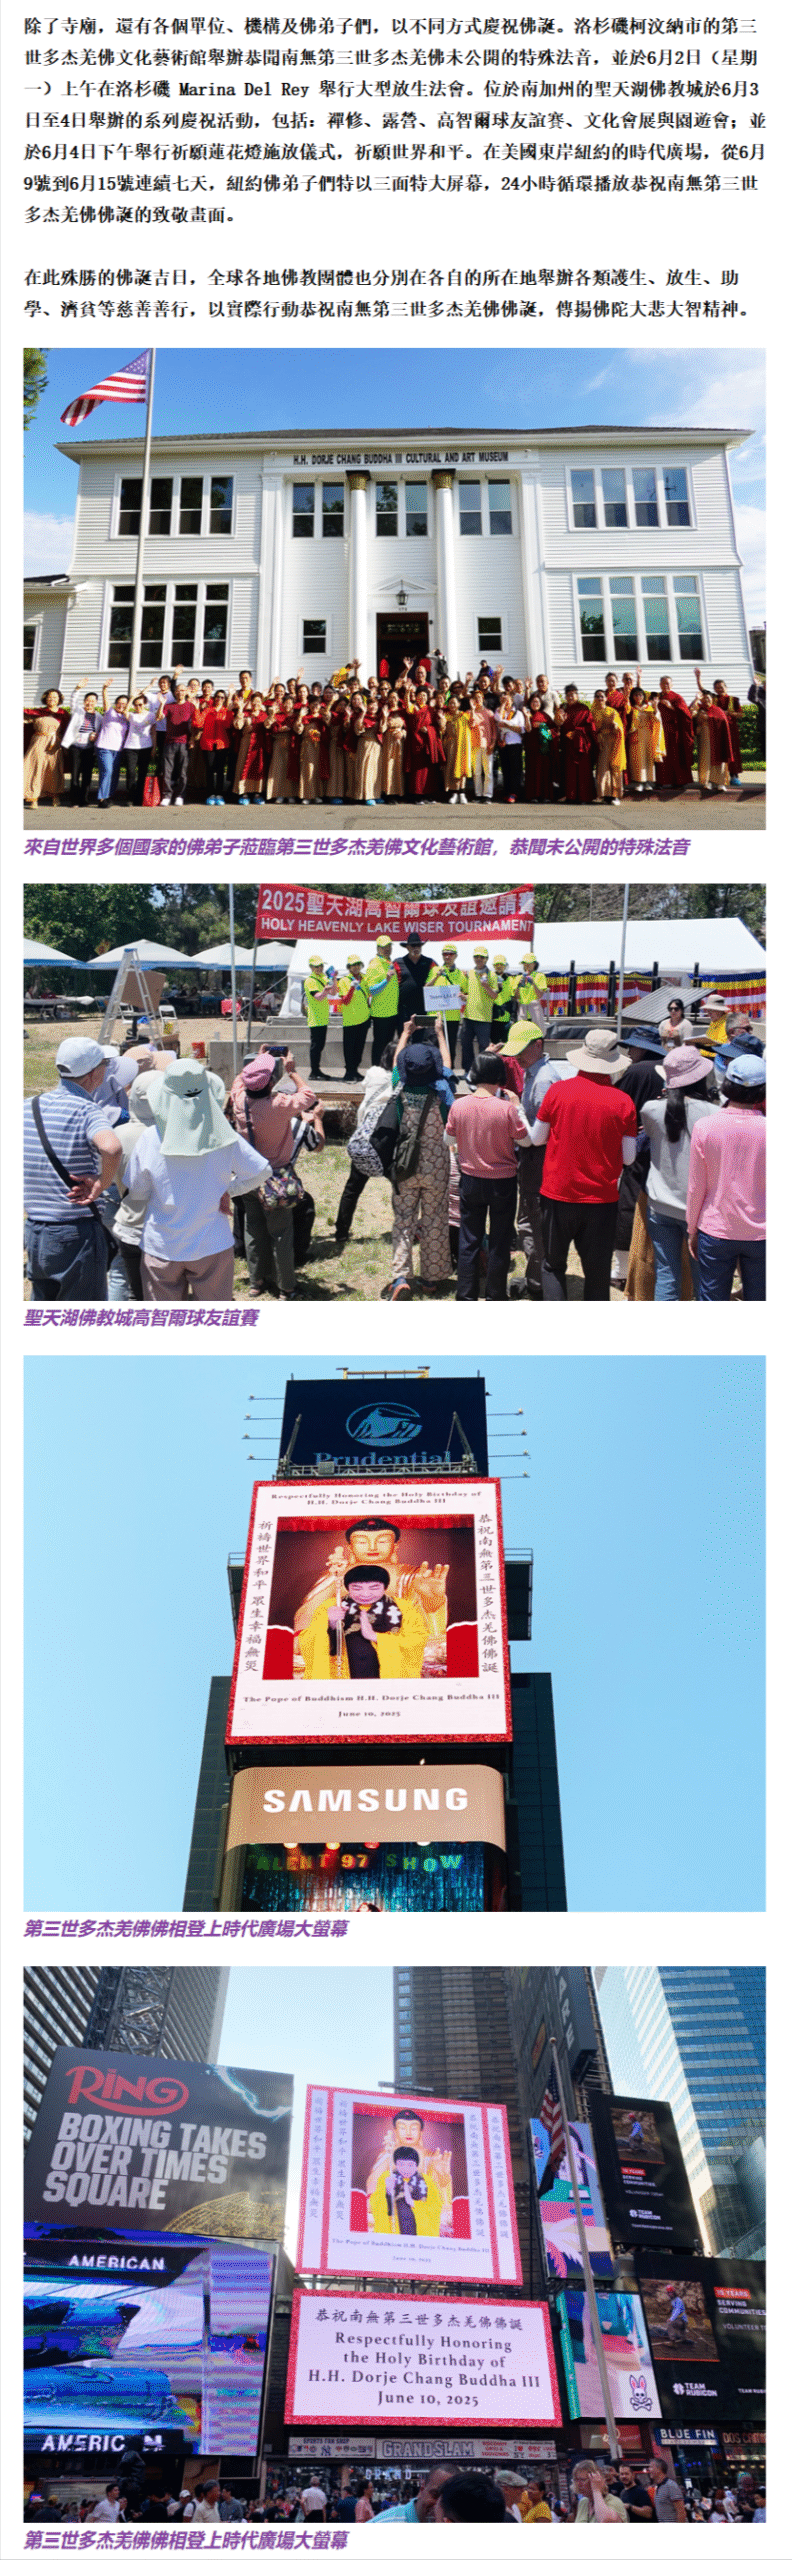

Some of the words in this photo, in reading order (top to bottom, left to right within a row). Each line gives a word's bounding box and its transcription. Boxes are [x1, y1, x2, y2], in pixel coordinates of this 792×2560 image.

[293, 455, 309, 465] H.H.
[311, 455, 334, 465] DORJE
[336, 454, 361, 465] CHANG
[364, 454, 392, 464] BUDDHA
[406, 453, 441, 464] CULTURAL
[444, 452, 459, 463] AND
[462, 452, 476, 463] ART
[478, 451, 509, 462] MUSEUM
[261, 917, 295, 931] HOLY
[298, 919, 365, 933] HEAVENLY
[367, 920, 400, 933] LAKE
[404, 920, 445, 933] WISER
[448, 919, 534, 933] TOURNAMENT
[314, 1450, 452, 1467] Prudential
[265, 1696, 288, 1704] Pope
[382, 1695, 410, 1703] Dorje
[412, 1694, 443, 1702] Chang
[263, 1787, 469, 1814] SAMSUNG
[249, 1853, 331, 1872] ALENT
[341, 1853, 370, 1870] 97
[385, 1853, 464, 1873] SHOW
[57, 2112, 172, 2150] BOXING
[180, 2122, 267, 2160] TAKES
[50, 2141, 133, 2176] OVER
[140, 2147, 228, 2185] TIMES
[42, 2170, 170, 2211] SQUARE
[68, 2254, 165, 2271] AMERICAN
[717, 2299, 748, 2307] SERVING
[722, 2323, 760, 2331] VOLUNTEER
[335, 2331, 435, 2350] Respectfully
[440, 2336, 513, 2353] Honoring
[344, 2350, 369, 2364] the
[375, 2352, 412, 2368] Holy
[418, 2353, 485, 2371] Birthday
[490, 2356, 507, 2368] of
[308, 2369, 345, 2383] H.H.
[352, 2370, 398, 2387] Dorje
[403, 2371, 453, 2388] Chang
[459, 2373, 517, 2388] Buddha
[522, 2375, 541, 2388] III
[378, 2391, 415, 2406] June
[420, 2394, 441, 2407] 10,
[446, 2395, 480, 2408] 2025
[686, 2389, 717, 2397] RUBICON
[660, 2429, 691, 2439] BLUE
[695, 2429, 716, 2439] FIN
[41, 2434, 166, 2452] AMERICN
[383, 2440, 432, 2458] GRAND
[434, 2440, 475, 2458] SLAM
